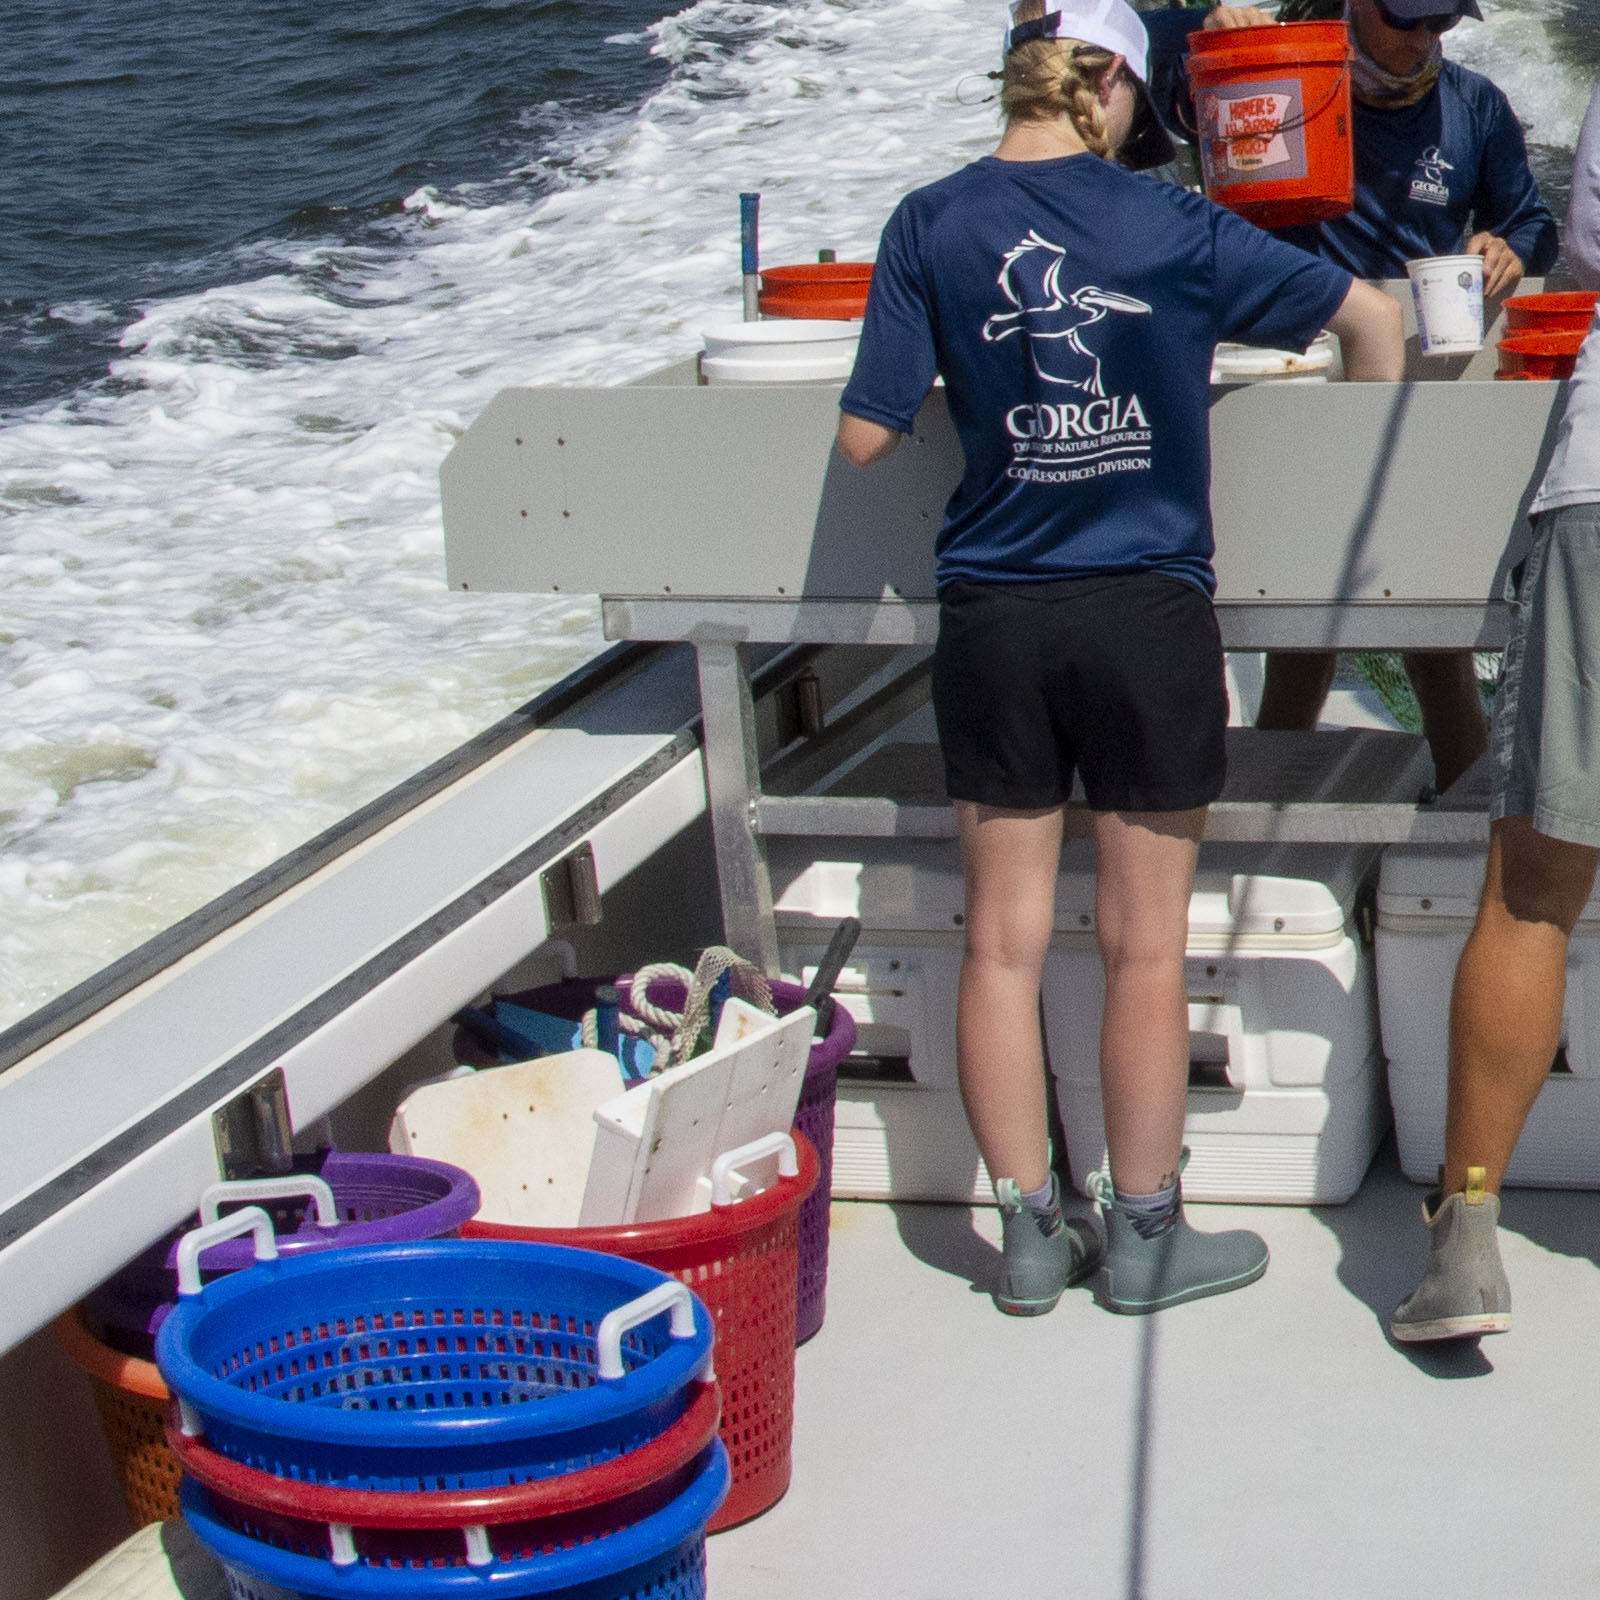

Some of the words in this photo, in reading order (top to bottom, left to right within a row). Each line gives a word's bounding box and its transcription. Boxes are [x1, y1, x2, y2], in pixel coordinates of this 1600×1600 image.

[1411, 180, 1449, 197] GEORGIA
[1054, 438, 1100, 453] NATURAL
[1098, 457, 1151, 475] DIVISION
